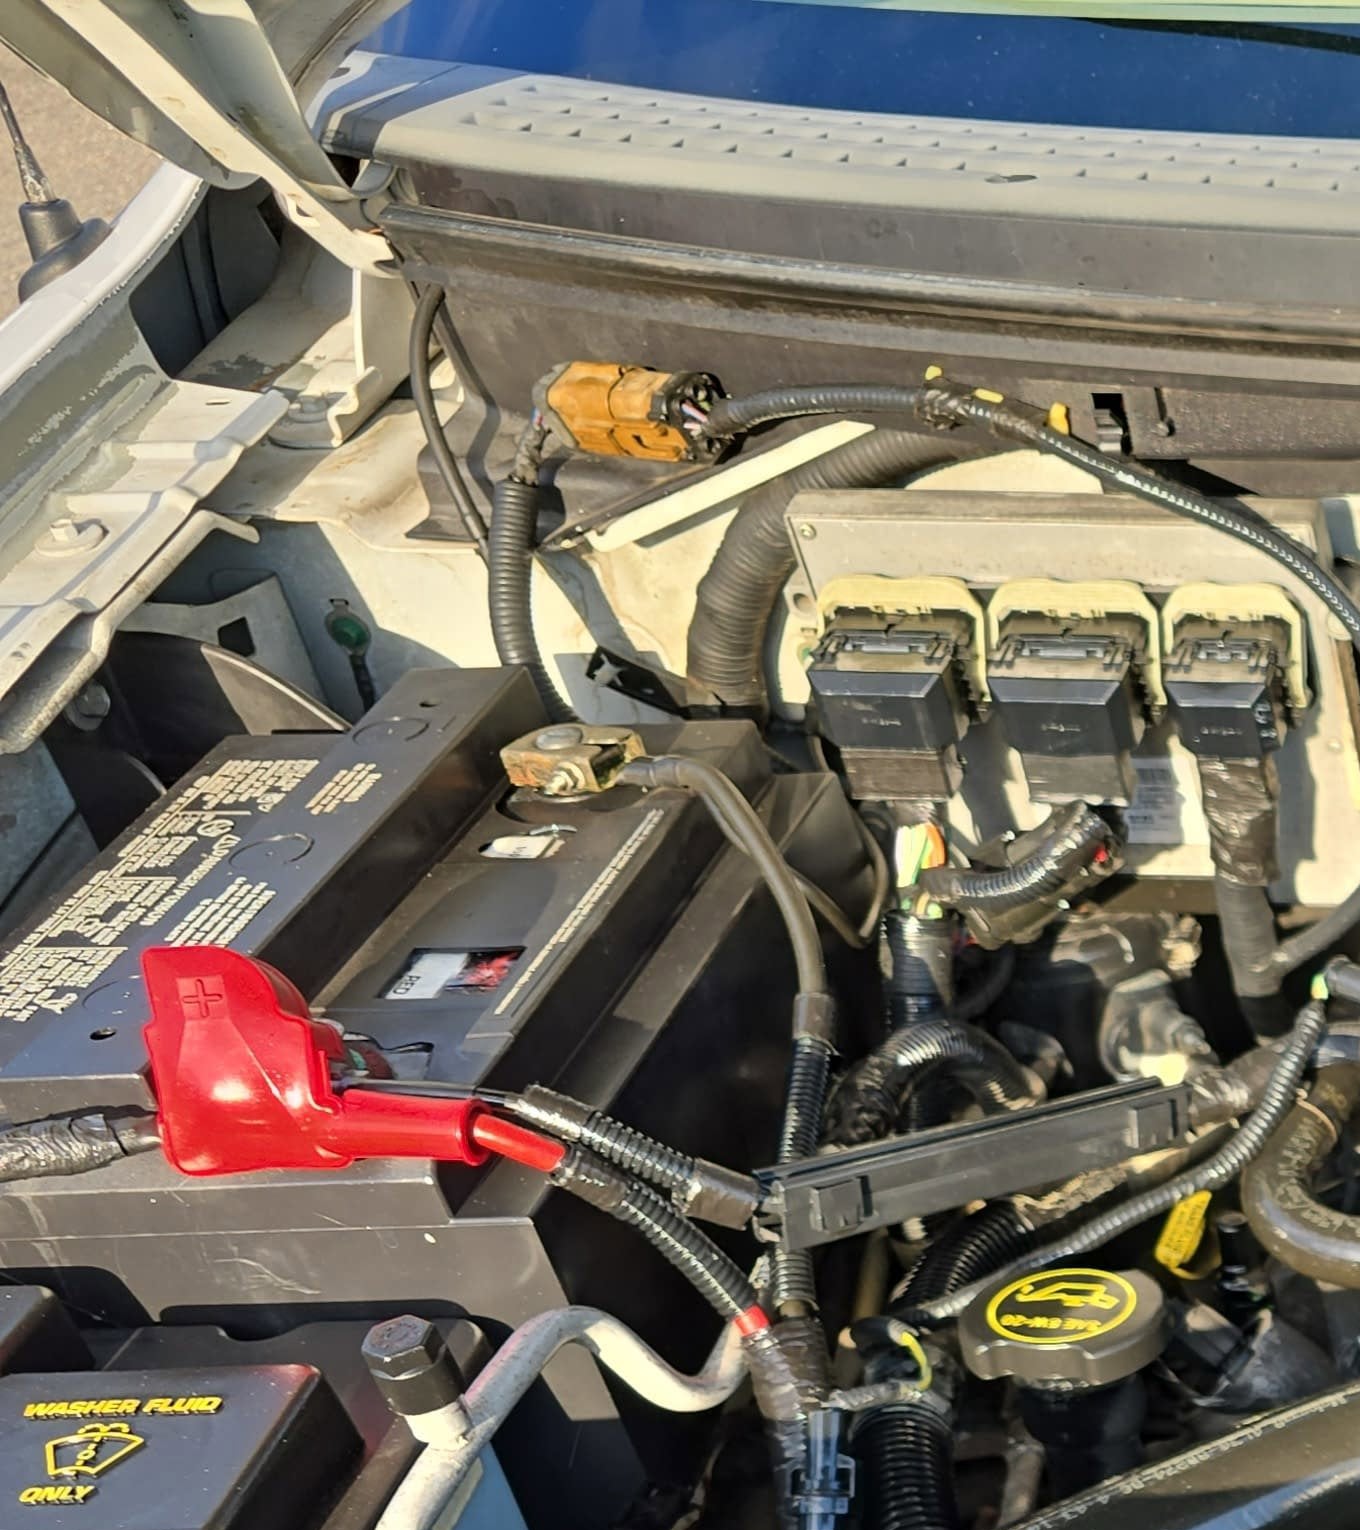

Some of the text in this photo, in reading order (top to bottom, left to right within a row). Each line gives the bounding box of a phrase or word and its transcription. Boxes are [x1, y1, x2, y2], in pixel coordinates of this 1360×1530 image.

[391, 974, 421, 996] RED
[1061, 1318, 1102, 1333] SAE
[23, 1395, 223, 1419] WASHER FLUID
[19, 1485, 95, 1504] ONLY
